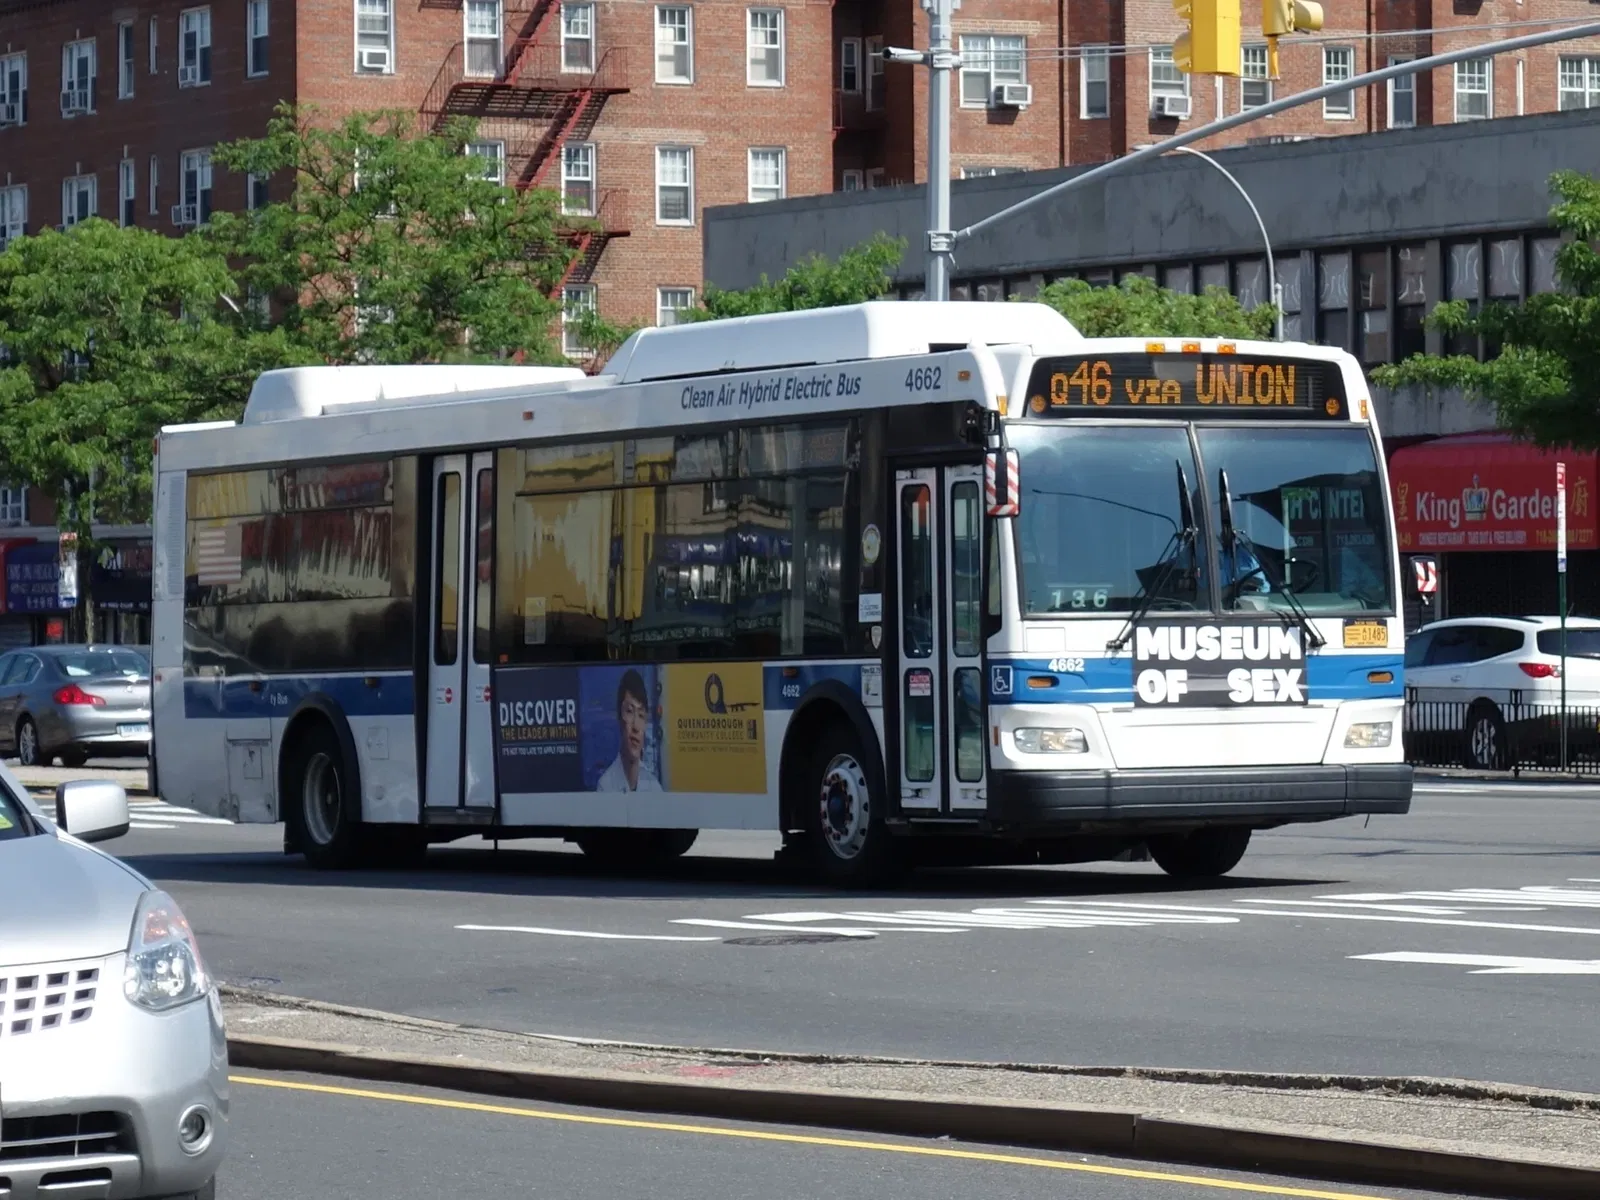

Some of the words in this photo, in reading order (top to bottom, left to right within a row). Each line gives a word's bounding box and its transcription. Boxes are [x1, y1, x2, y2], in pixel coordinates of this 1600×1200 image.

[681, 385, 715, 410] Clean
[716, 383, 736, 407] Air
[738, 377, 781, 410] Hybrid
[784, 373, 832, 401] Electric
[836, 372, 862, 396] Bus
[905, 365, 942, 392] 4662
[1050, 360, 1113, 406] Q46
[1125, 379, 1181, 404] VIA
[1195, 363, 1296, 405] UNION
[1416, 491, 1460, 529] King
[1136, 625, 1302, 661] MUSEUM
[1048, 658, 1085, 672] 4662
[781, 684, 801, 697] 4662
[1136, 668, 1188, 704] OF
[1227, 668, 1304, 703] SEX
[499, 699, 576, 726] DISCOVER
[677, 718, 744, 729] QUEENSBOROUGH
[501, 727, 515, 740] THE
[517, 726, 548, 740] LEADER
[549, 725, 577, 739] WITHIN
